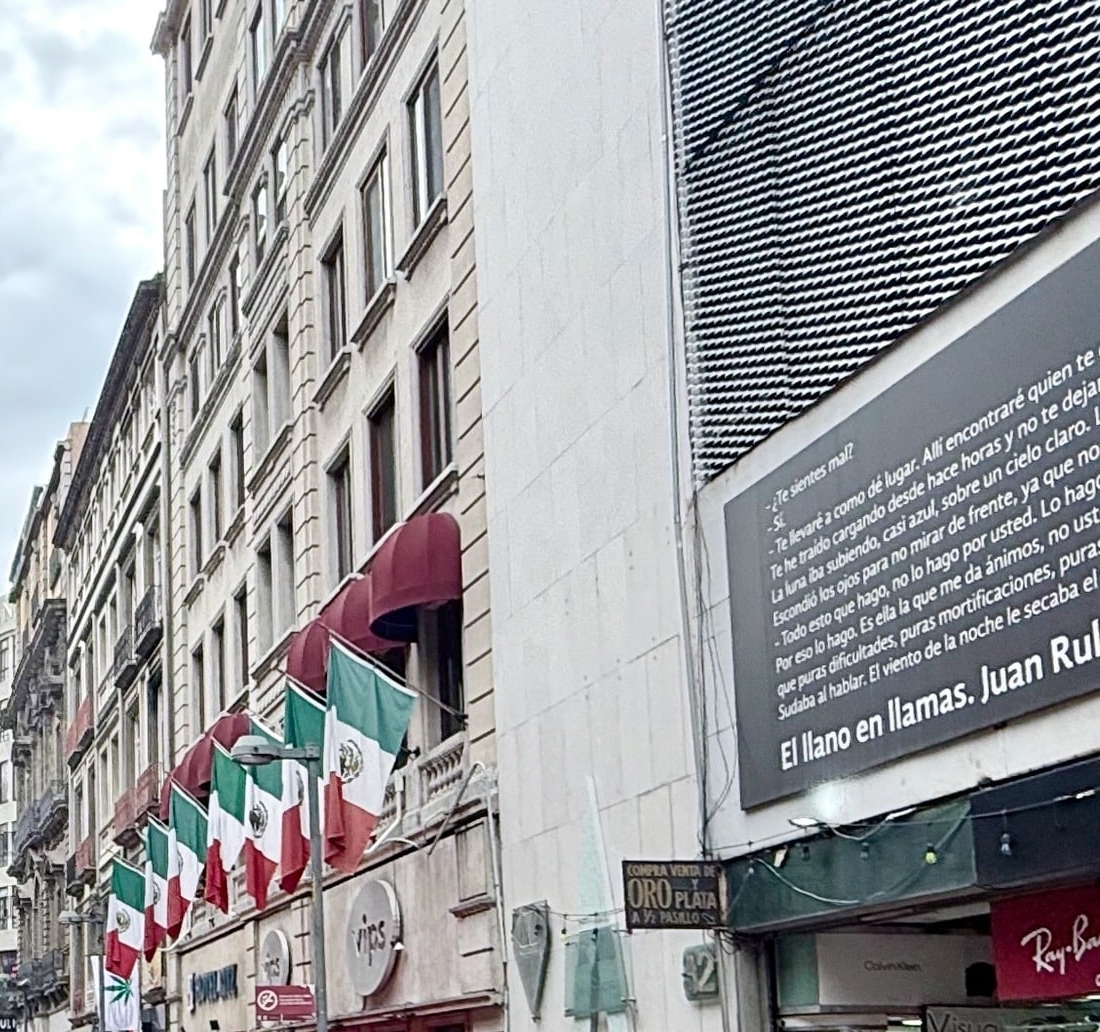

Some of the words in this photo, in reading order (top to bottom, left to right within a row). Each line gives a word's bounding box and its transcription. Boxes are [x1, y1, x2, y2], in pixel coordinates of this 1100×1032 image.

[769, 563, 783, 580] Te
[783, 556, 797, 573] he
[798, 535, 830, 564] traído
[831, 503, 886, 545] cargando
[887, 480, 925, 513] desde
[926, 462, 959, 490] hace
[960, 437, 1002, 471] horas
[1003, 429, 1013, 452] y
[1016, 416, 1038, 439] no
[1040, 403, 1058, 424] te
[771, 488, 789, 512] ¿Te
[789, 464, 827, 497] sientes
[827, 441, 853, 472] mal?
[771, 588, 784, 604] La
[784, 575, 807, 596] luna
[808, 565, 824, 583] iba
[825, 534, 881, 574] subiendo,
[882, 514, 906, 542] casi
[907, 497, 939, 528] azul,
[940, 478, 980, 511] sobre
[982, 466, 1002, 488] un
[1004, 443, 1042, 475] cielo
[1044, 419, 1091, 453] claro.
[774, 536, 788, 553] Te
[788, 511, 823, 546] llevaré
[824, 511, 832, 525] a
[833, 490, 865, 519] como
[866, 473, 883, 498] dé
[884, 457, 920, 488] lugar.
[921, 436, 943, 466] Allí
[945, 386, 1025, 451] encontraré
[1027, 363, 1072, 404] quien
[1075, 349, 1095, 371] te
[772, 511, 786, 531] Sí.
[772, 589, 818, 626] Escondió
[818, 584, 835, 603] los
[836, 571, 860, 596] ojos
[861, 556, 889, 585] para
[890, 546, 908, 565] no
[909, 525, 945, 555] mirar
[947, 514, 966, 535] de
[967, 490, 1018, 525] frente,
[1019, 476, 1040, 504] ya
[1042, 457, 1075, 488] que
[1077, 444, 1100, 467] no
[780, 622, 807, 646] Todo
[808, 612, 832, 632] esto
[833, 600, 855, 623] que
[856, 584, 890, 609] hago,
[891, 572, 909, 592] no
[910, 563, 924, 582] lo
[925, 547, 959, 575] hago
[962, 532, 987, 562] por
[990, 504, 1038, 543] usted.
[1040, 496, 1061, 518] Lo
[775, 654, 793, 673] Por
[794, 646, 813, 664] eso
[814, 638, 825, 655] lo
[826, 626, 858, 649] hago.
[859, 615, 874, 634] Es
[874, 603, 897, 626] ella
[897, 597, 911, 615] la
[911, 586, 937, 611] que
[939, 574, 962, 596] me
[964, 562, 983, 584] da
[984, 537, 1044, 575] ánimos,
[1047, 523, 1069, 546] no
[1072, 506, 1100, 533] ust
[776, 678, 796, 699] que
[797, 664, 827, 692] puras
[828, 633, 898, 674] dificultades,
[899, 615, 937, 647] puras
[937, 563, 1055, 626] mortificaciones,
[777, 693, 816, 720] Sudaba
[817, 684, 827, 704] al
[828, 673, 867, 699] hablar.
[868, 661, 880, 683] El
[882, 649, 922, 676] viento
[923, 639, 942, 659] de
[942, 632, 957, 652] la
[958, 615, 1004, 646] noche
[1005, 605, 1021, 626] le
[1023, 582, 1080, 619] secaba
[1082, 567, 1099, 592] el
[780, 735, 798, 770] El
[801, 726, 851, 762] llano
[855, 713, 883, 742] en
[887, 682, 974, 732] llamas.
[980, 654, 1043, 704] Juan
[1050, 617, 1100, 674] Rul
[627, 864, 668, 877] COMPRA
[669, 864, 701, 877] VENTA
[703, 865, 716, 877] DE
[627, 877, 673, 909] ORO
[660, 911, 700, 924] PASILLO
[674, 891, 718, 909] PLATA
[691, 878, 699, 890] Y
[351, 913, 386, 967] vips
